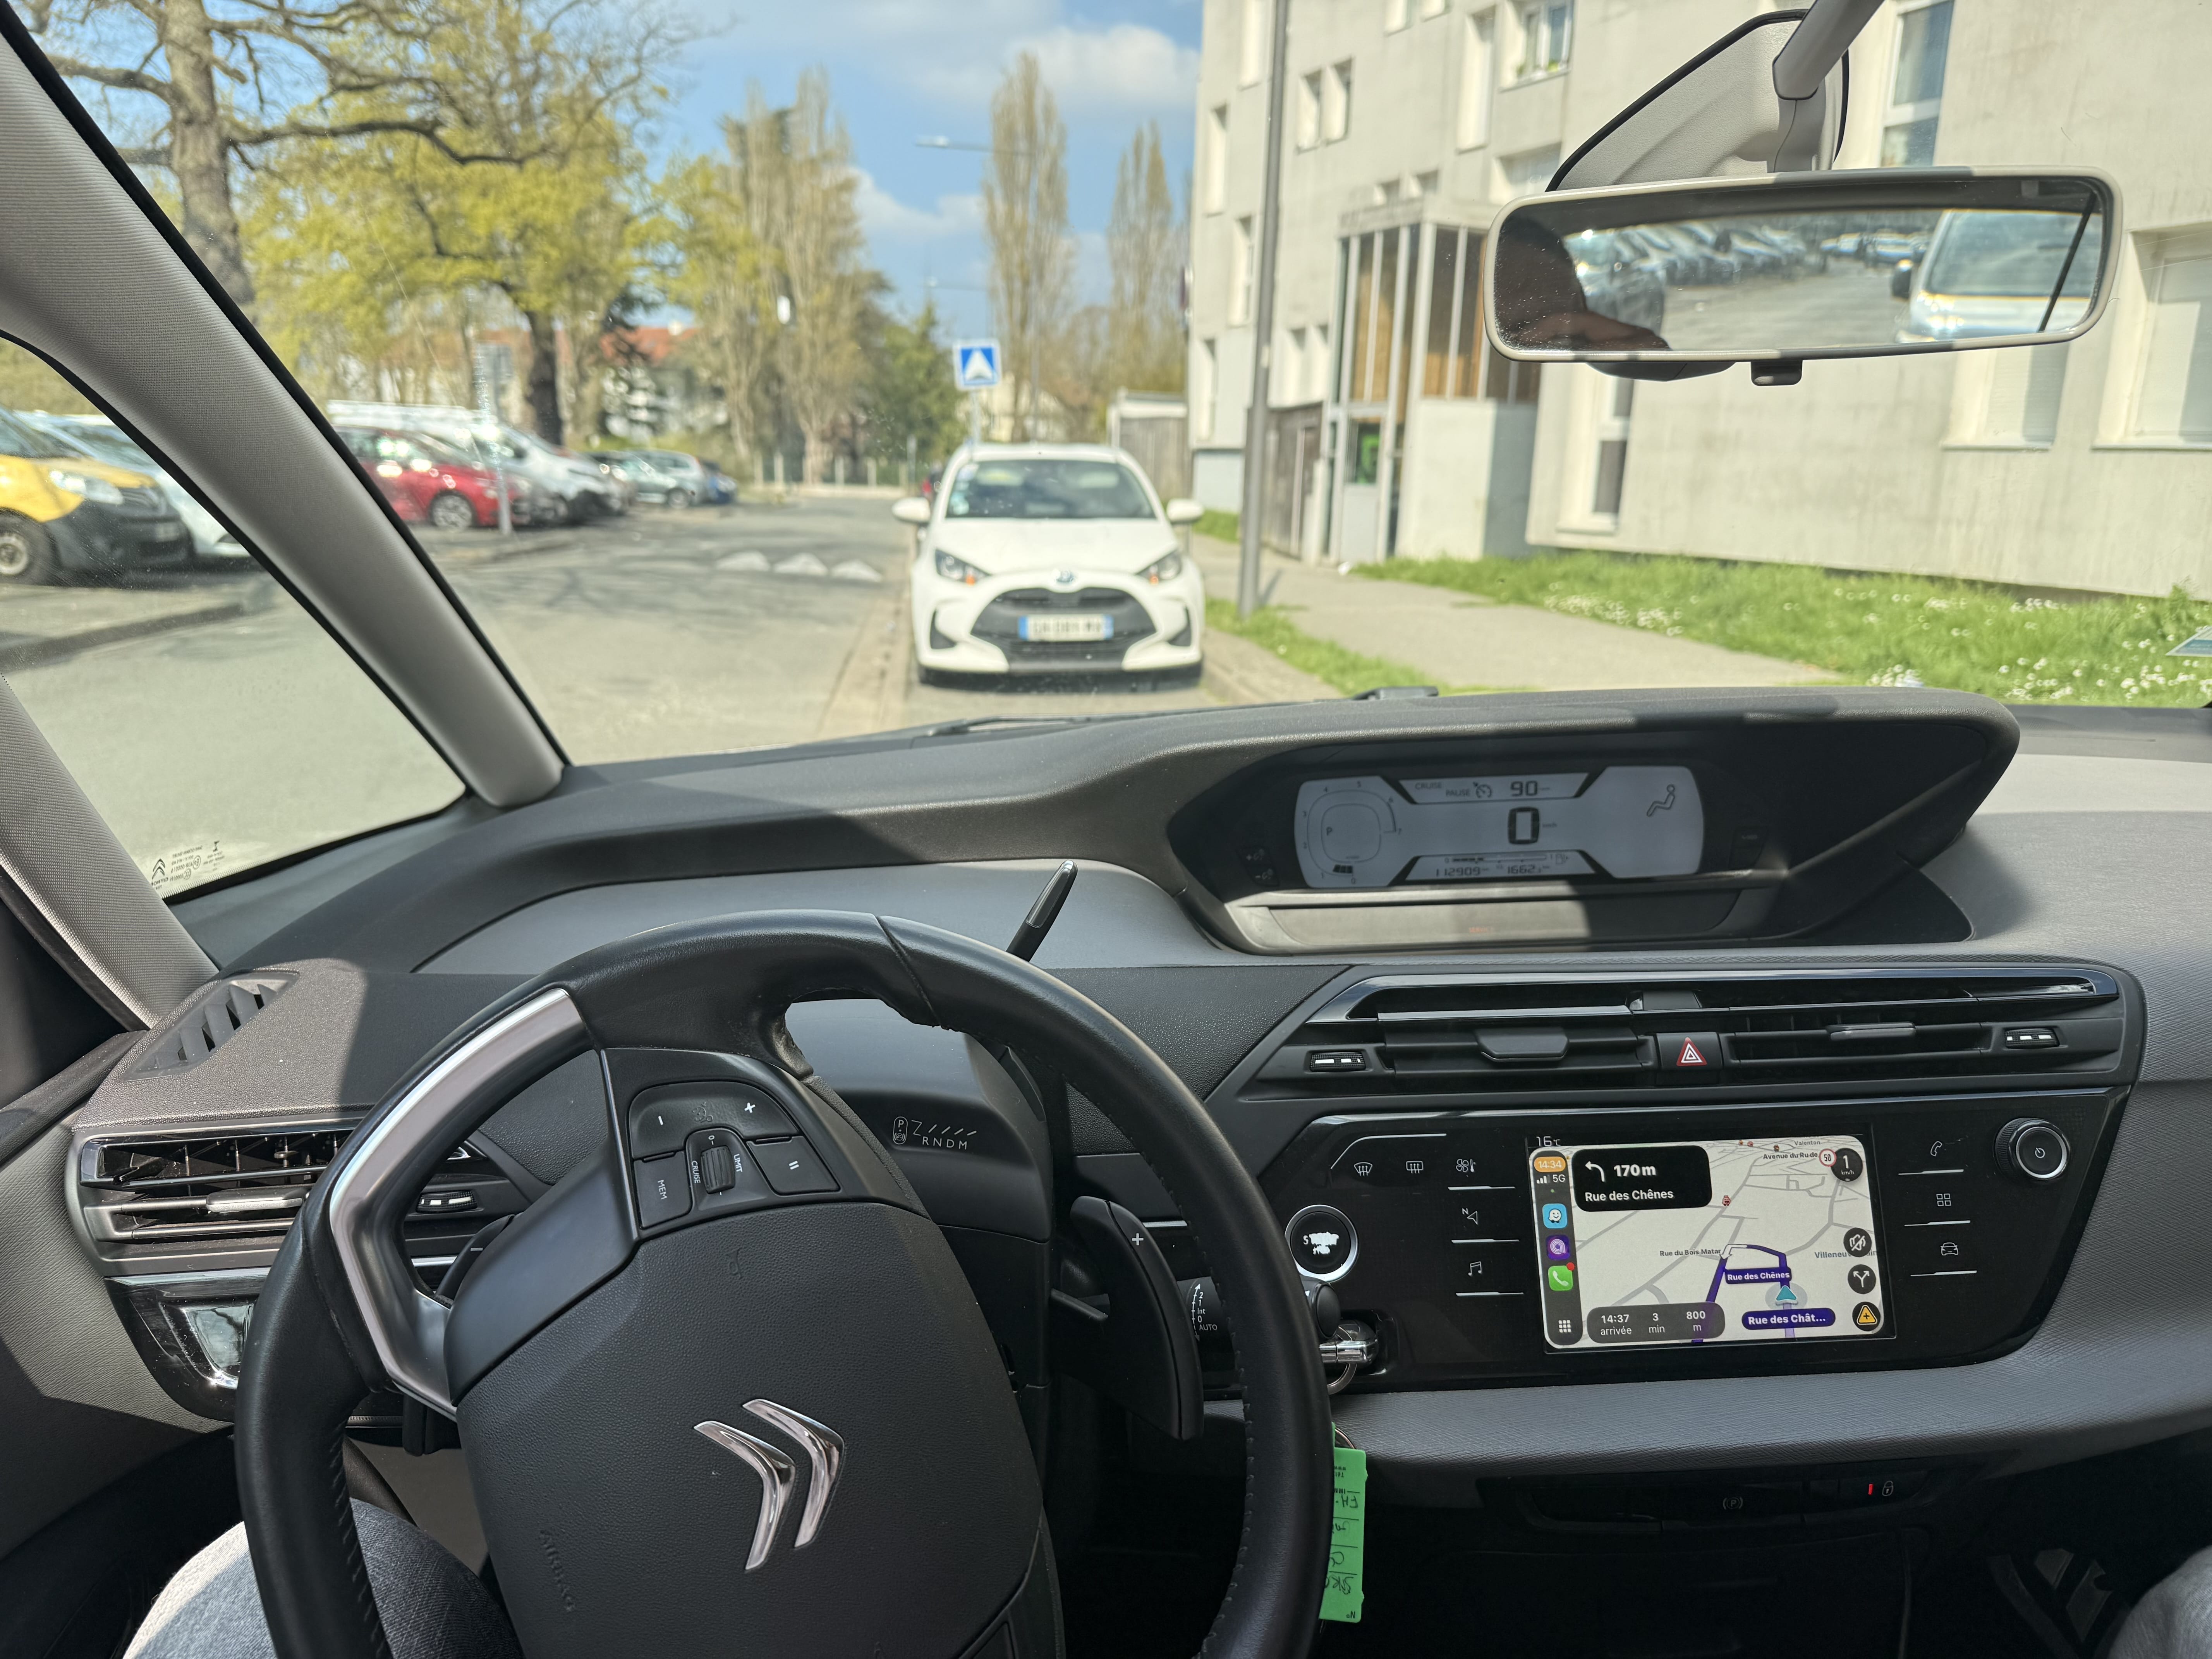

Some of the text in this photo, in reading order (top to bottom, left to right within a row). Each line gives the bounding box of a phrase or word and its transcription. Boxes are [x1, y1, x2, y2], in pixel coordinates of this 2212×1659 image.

[1415, 781, 1442, 790] CRUISE
[1510, 780, 1539, 797] 90
[1445, 788, 1470, 797] PAUSE
[1507, 806, 1540, 845] 0
[1326, 827, 1333, 836] P
[1436, 866, 1481, 877] 112909
[898, 1119, 904, 1128] P
[1824, 1154, 1831, 1162] 50
[1843, 1155, 1849, 1169] 1
[733, 1154, 743, 1173] LIMIT
[1538, 1159, 1562, 1169] 14:34
[691, 1160, 701, 1184] CRUISE
[1552, 1175, 1566, 1183] 5G
[657, 1179, 668, 1200] MEM
[1585, 1188, 1674, 1202] Rue des Chênes
[1760, 1271, 1790, 1279] Chênes
[1601, 1314, 1630, 1324] 14:37
[1652, 1313, 1659, 1321] 3
[1686, 1310, 1706, 1320] 800
[1748, 1316, 1769, 1325] Rue
[1771, 1315, 1788, 1324] des
[1600, 1326, 1632, 1336] arrivée
[1648, 1324, 1665, 1333] min
